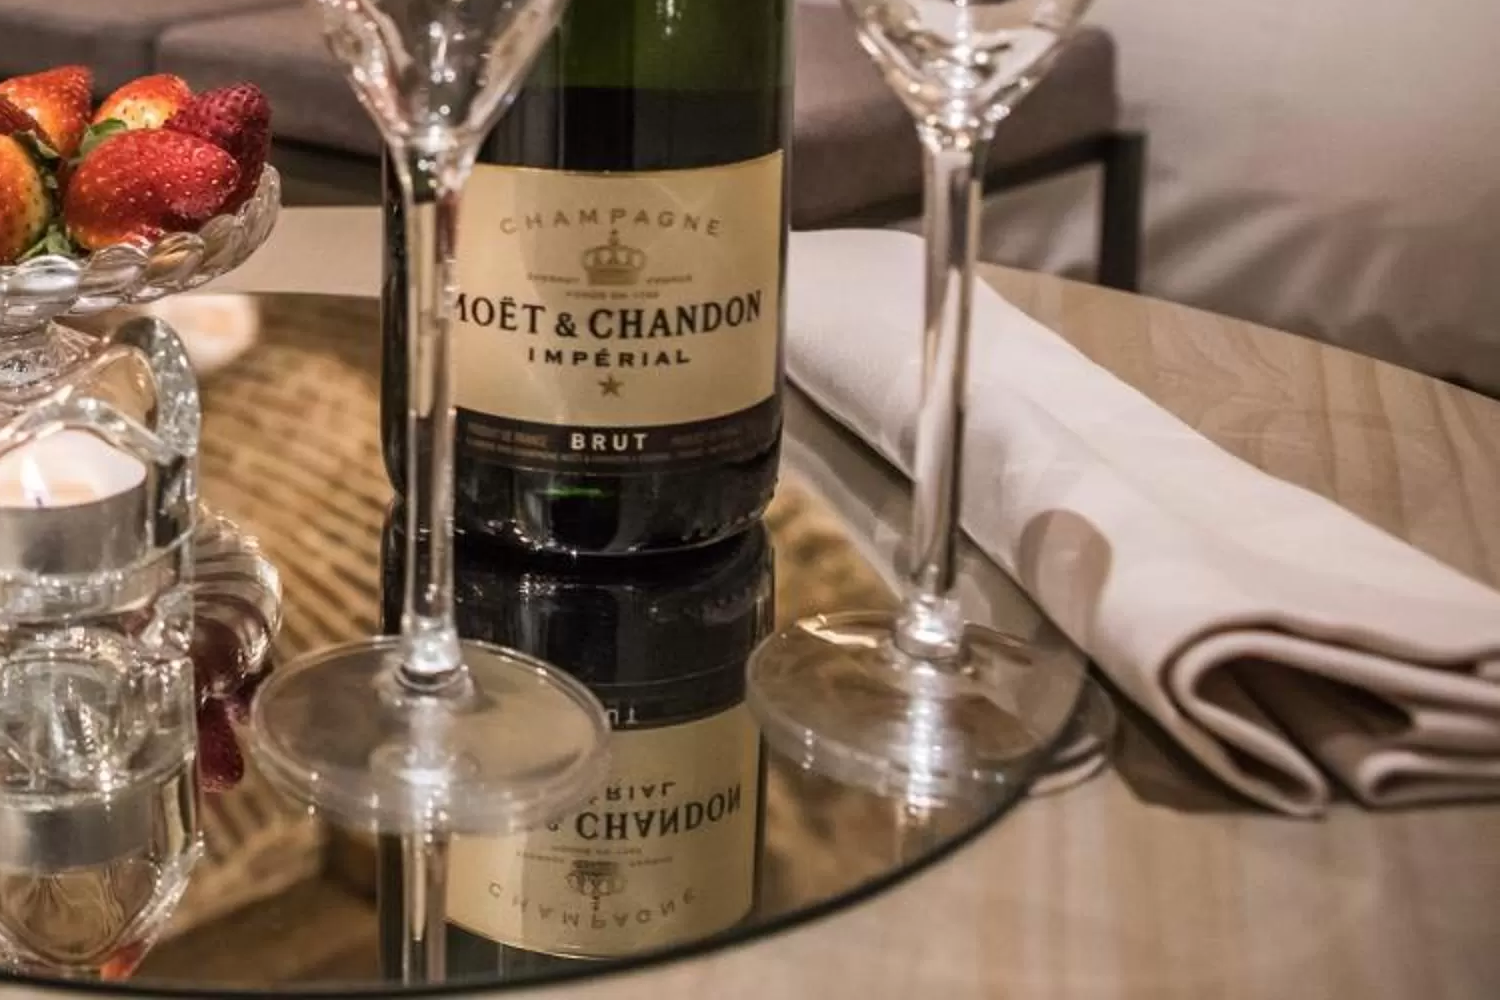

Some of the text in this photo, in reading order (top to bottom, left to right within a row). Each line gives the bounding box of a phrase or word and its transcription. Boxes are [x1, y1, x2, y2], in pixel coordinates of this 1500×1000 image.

[499, 207, 723, 237] CHAMPAGNE
[554, 311, 578, 338] &
[588, 289, 763, 340] CHANDON
[528, 346, 692, 369] IMPÉRIAL
[569, 431, 649, 451] BRUT
